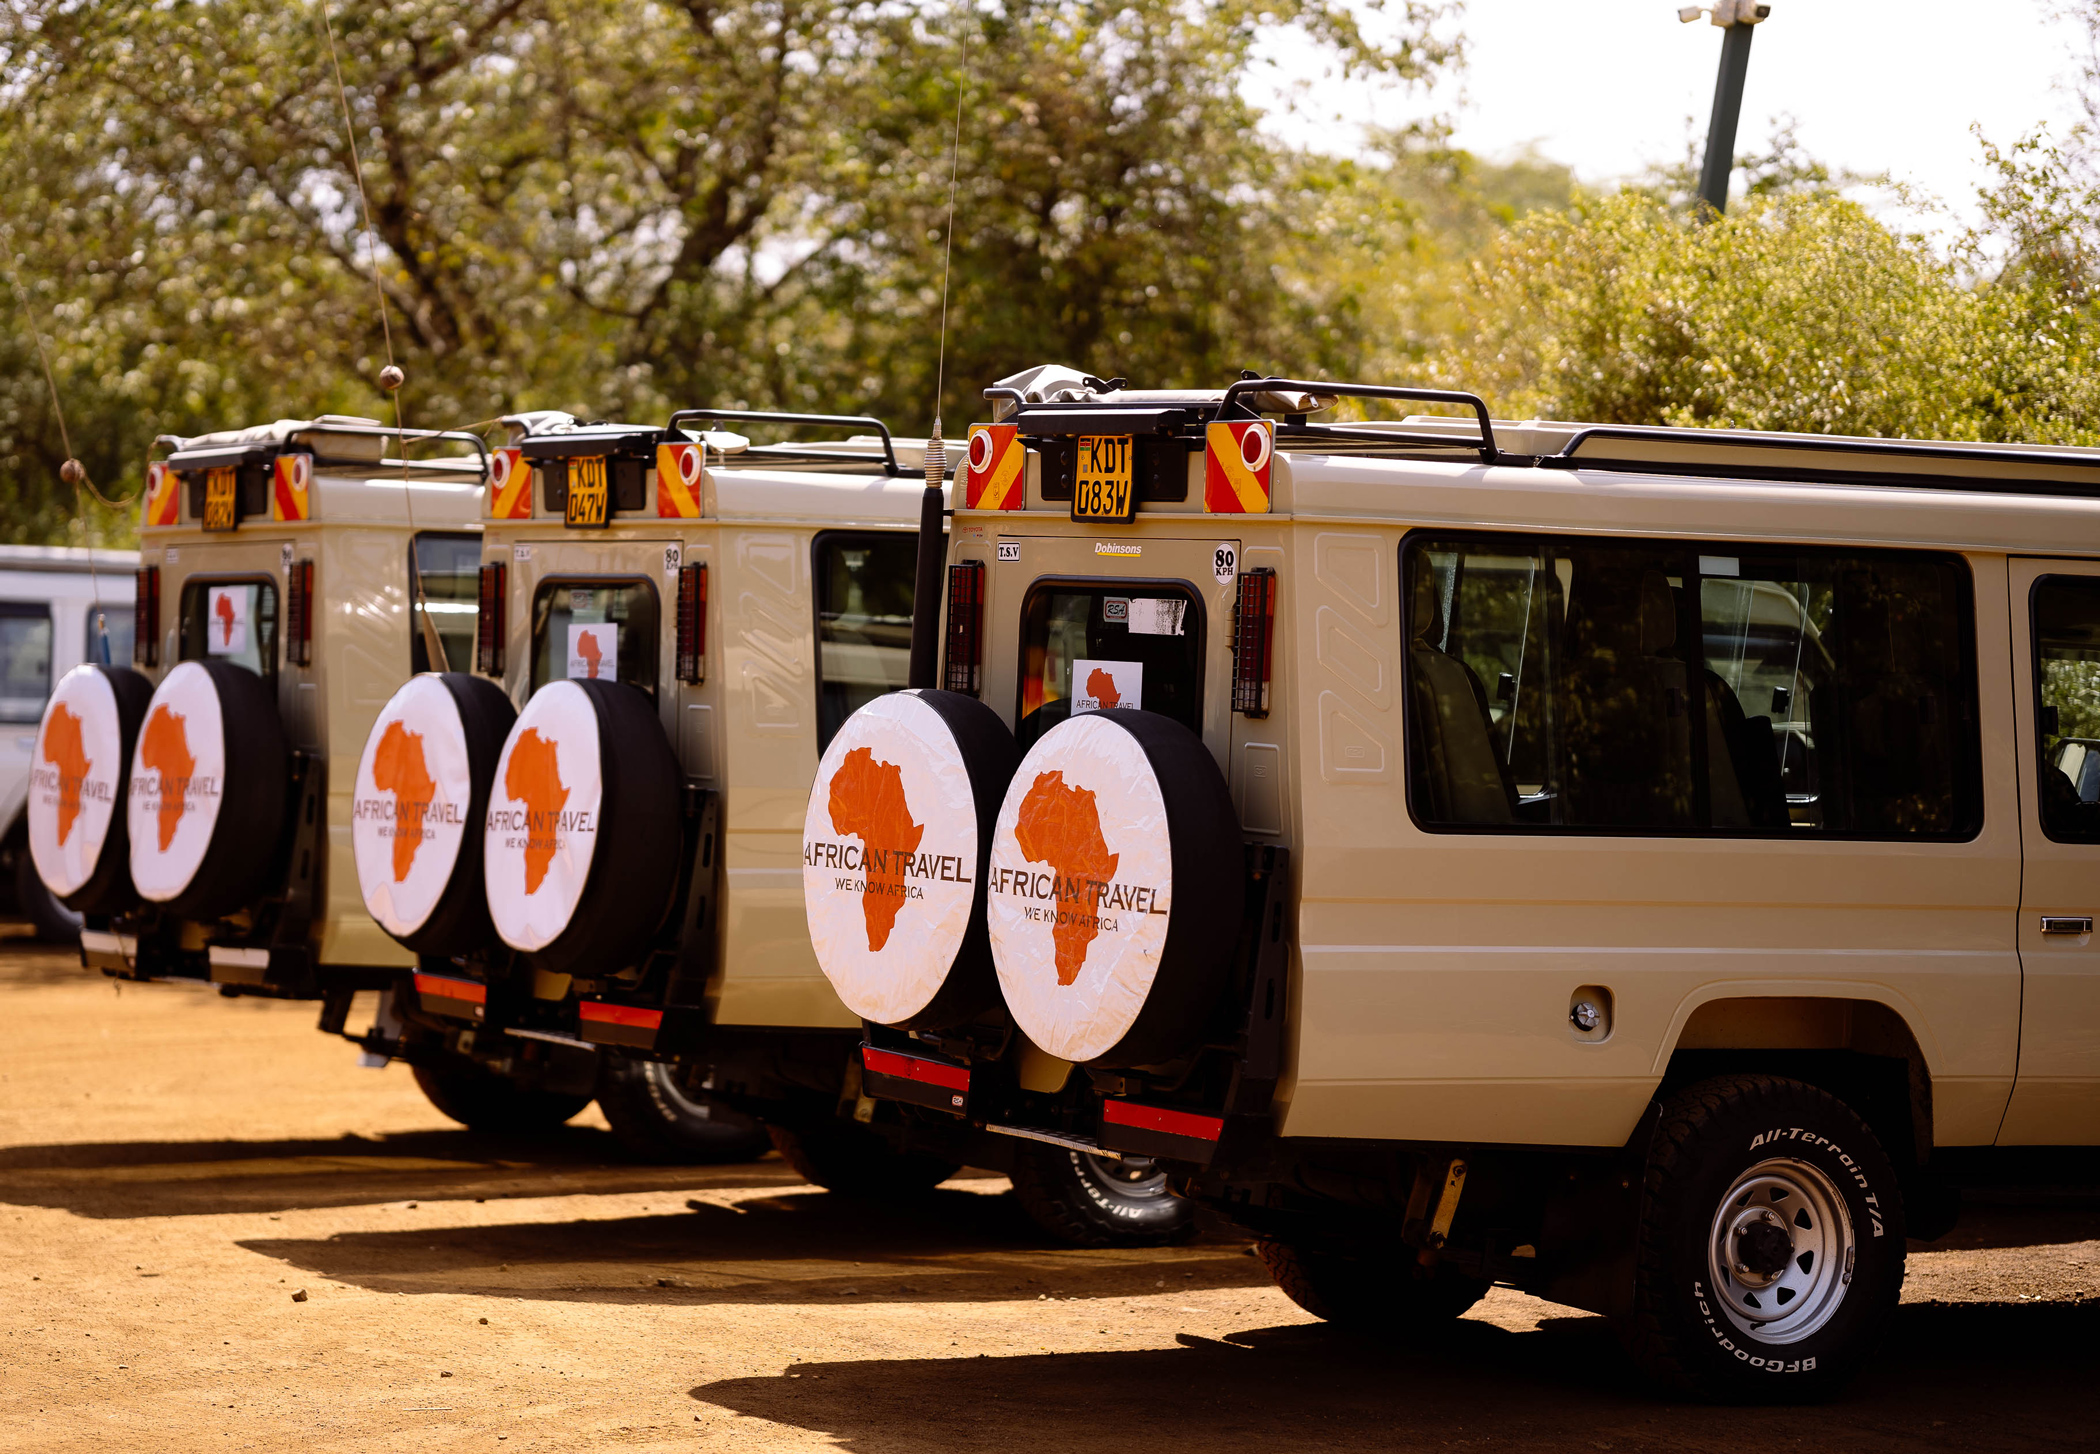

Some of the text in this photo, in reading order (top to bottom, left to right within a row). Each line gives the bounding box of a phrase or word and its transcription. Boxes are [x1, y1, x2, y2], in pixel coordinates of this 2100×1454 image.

[1091, 438, 1129, 473] KDT
[577, 458, 604, 488] KDT
[569, 493, 605, 522] 047W
[1078, 480, 1128, 515] 083W
[666, 549, 679, 562] 80
[999, 546, 1019, 557] T.S.V
[1095, 543, 1142, 554] Dobinsons
[1215, 549, 1235, 567] 80
[1216, 567, 1234, 576] KPH
[1106, 604, 1126, 614] RSA
[1076, 700, 1108, 709] AFRICAN
[353, 799, 463, 824] AFRICAN TRAVEL
[486, 810, 595, 832] AFRICAN TRAVEL
[804, 842, 972, 884] AFRICAN TRAVEL
[835, 877, 924, 899] WE KNOW AFRICA
[989, 867, 1168, 915] AFRICAN TRAVEL
[1024, 906, 1119, 932] WE KNOW AFRICA
[1750, 1127, 1884, 1238] All-Terrain T/A
[1694, 1281, 1817, 1373] BFGoodrich
